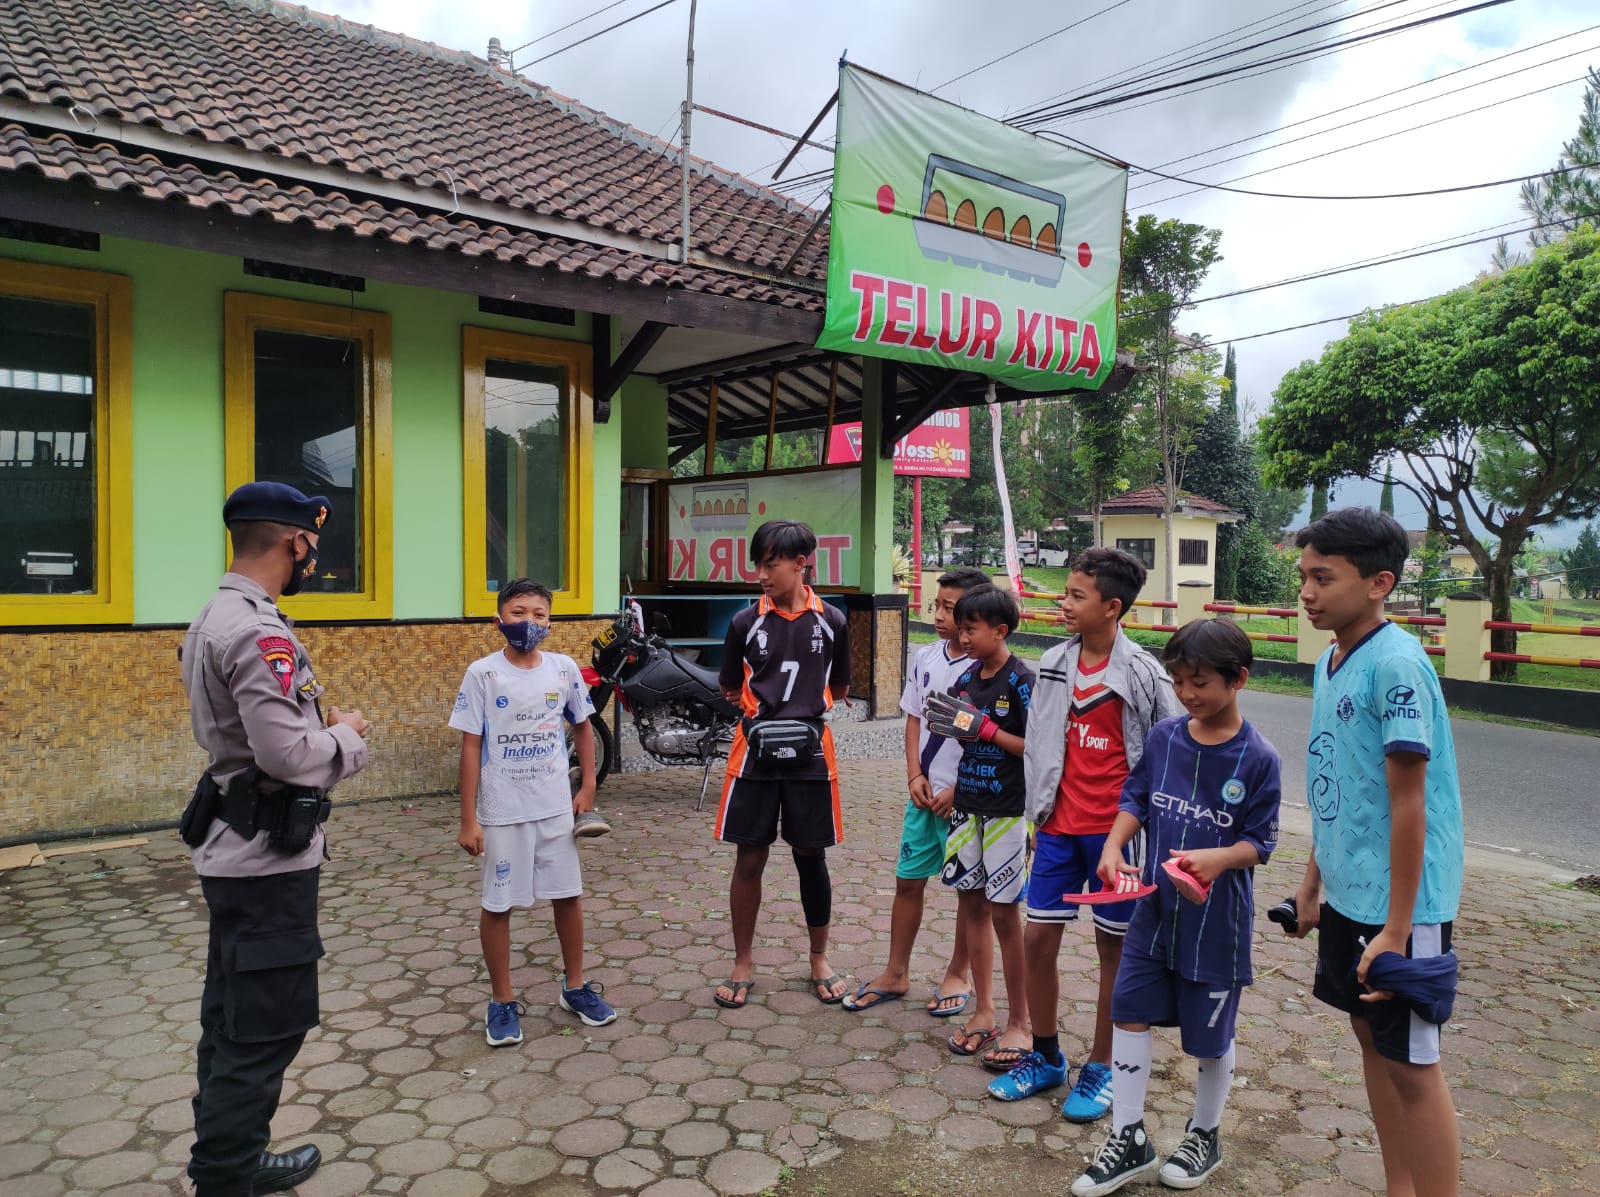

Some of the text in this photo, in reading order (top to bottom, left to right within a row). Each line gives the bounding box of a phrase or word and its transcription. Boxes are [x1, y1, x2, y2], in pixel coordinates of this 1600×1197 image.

[851, 271, 1103, 379] TELUR KITA
[780, 661, 800, 702] 7
[497, 731, 558, 744] DATSUN
[502, 742, 555, 761] Indofood
[1086, 736, 1109, 750] SPORT
[1152, 791, 1234, 828] ETIHAD
[1208, 990, 1230, 1028] 7
